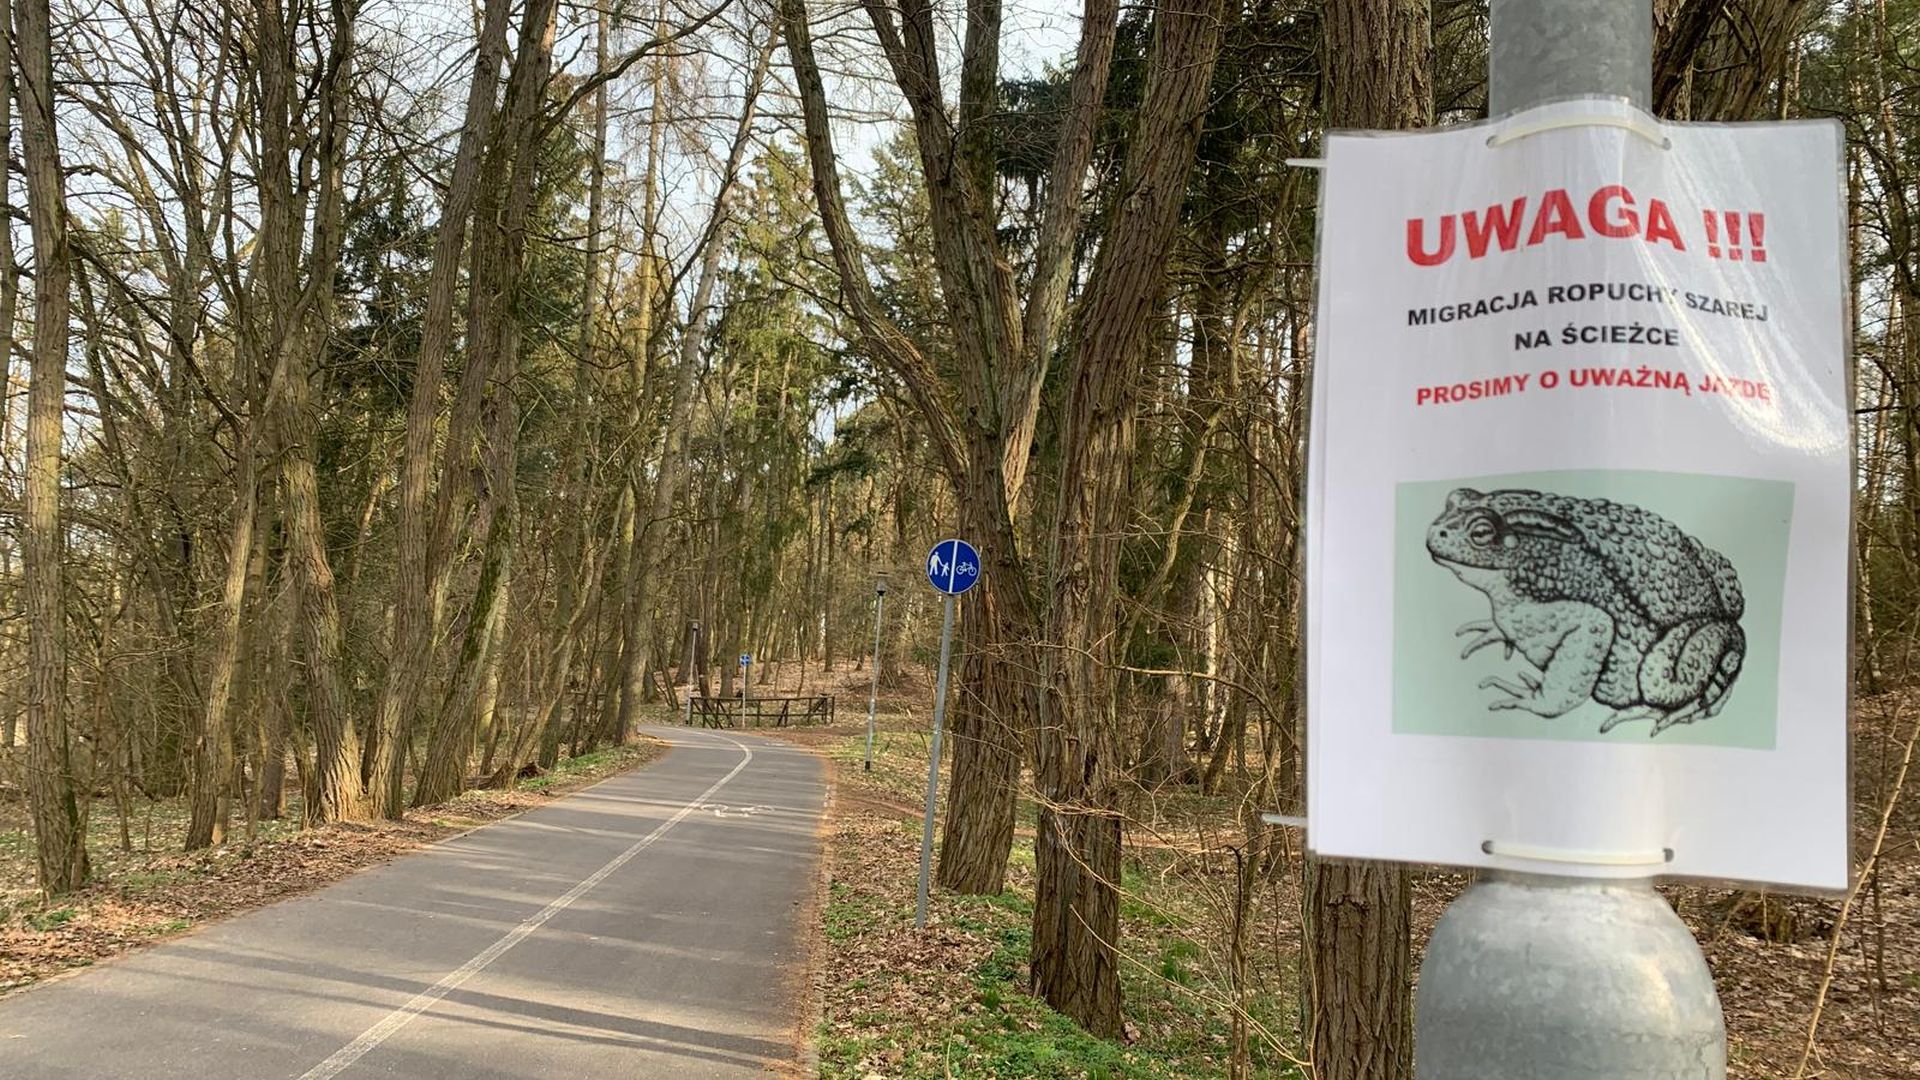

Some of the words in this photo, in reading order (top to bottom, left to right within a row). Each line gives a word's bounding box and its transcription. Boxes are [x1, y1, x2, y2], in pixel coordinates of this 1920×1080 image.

[1406, 184, 1686, 268] UWAGA
[1703, 208, 1767, 263] !!!
[1407, 290, 1538, 326] MIGRACJA
[1547, 282, 1677, 304] ROPUCHY
[1685, 291, 1769, 322] SZAREJ
[1514, 330, 1552, 350] NA
[1561, 322, 1679, 347] ŚCIEŻCE
[1416, 373, 1531, 406] PROSIMY
[1539, 370, 1559, 390] O
[1569, 364, 1690, 396] UWAŻNĄ
